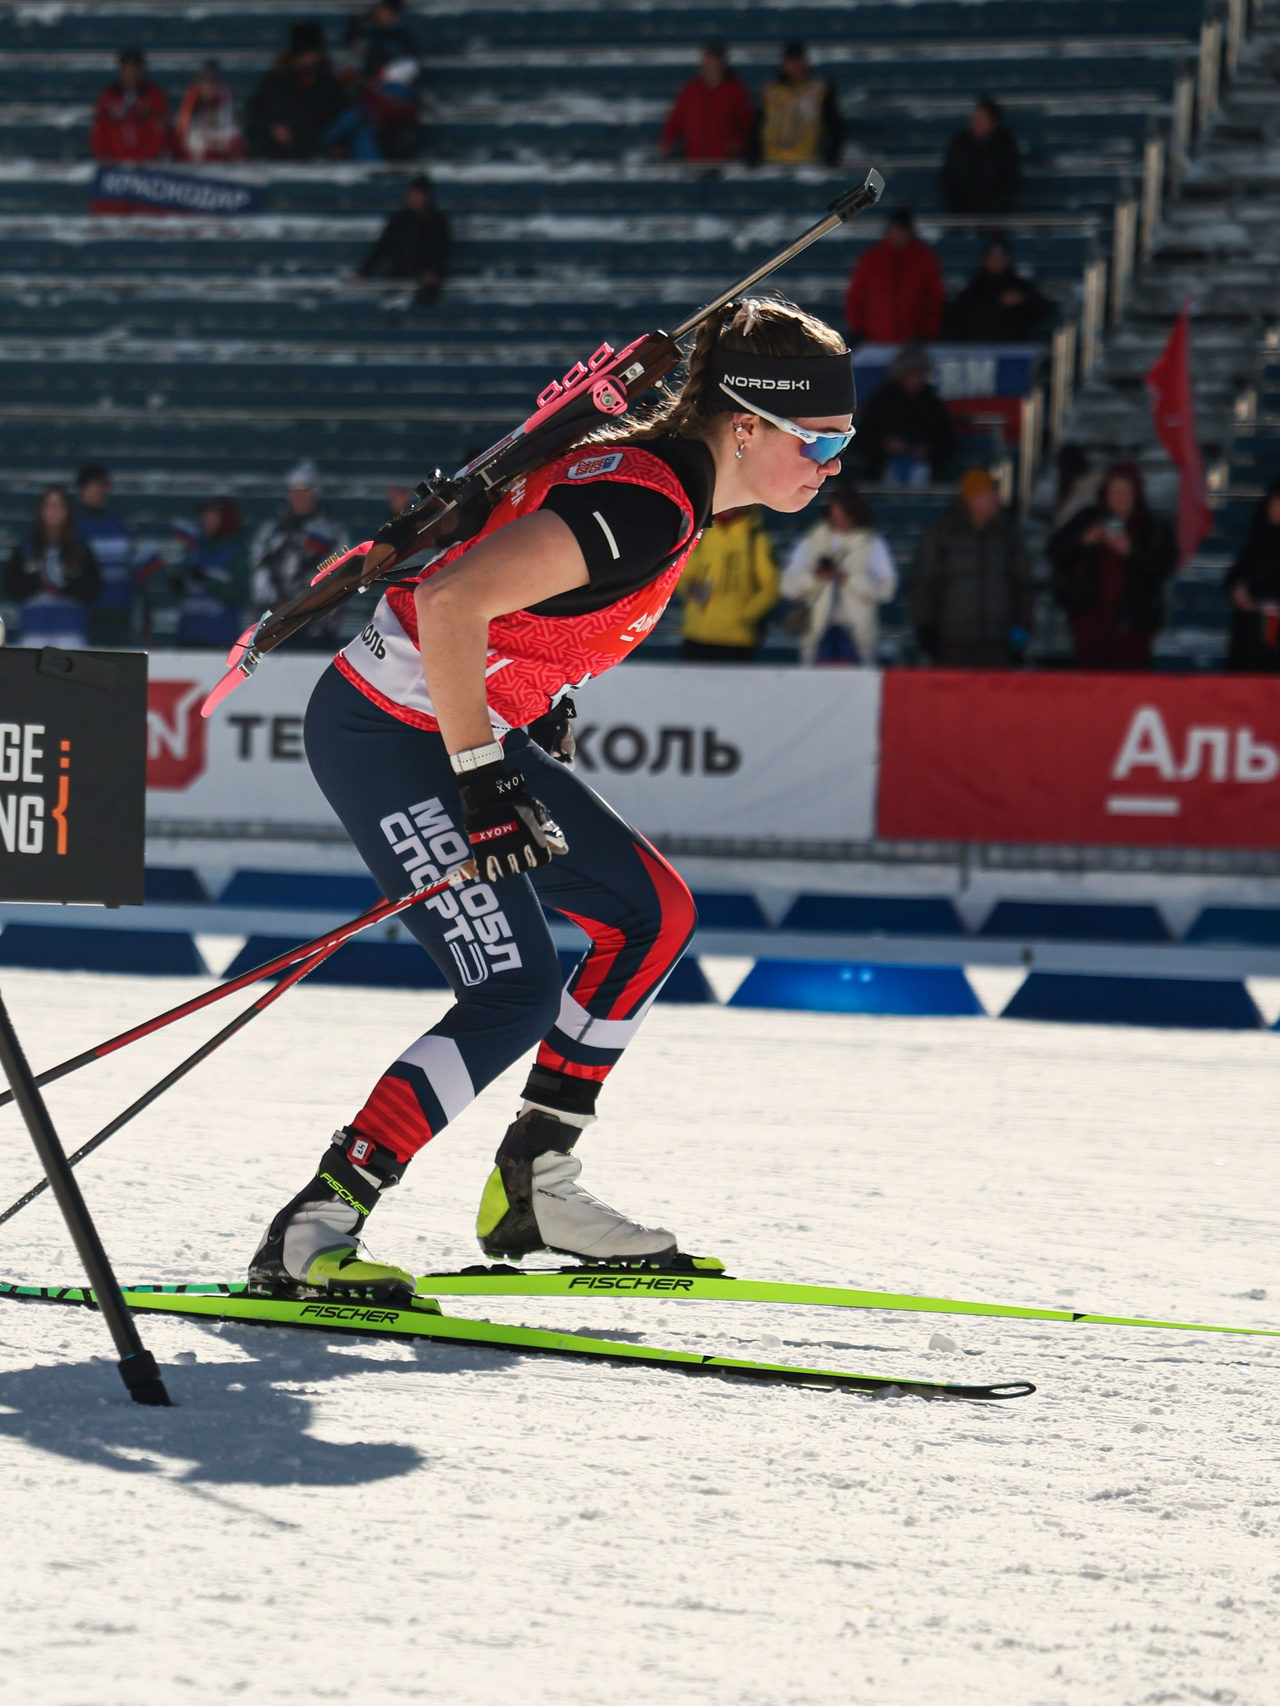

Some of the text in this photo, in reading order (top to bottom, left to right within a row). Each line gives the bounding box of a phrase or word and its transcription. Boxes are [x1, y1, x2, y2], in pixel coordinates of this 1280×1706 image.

[723, 374, 810, 391] NORDSKI
[361, 622, 386, 660] ОЛЬ
[479, 824, 513, 841] MOAX
[320, 1172, 370, 1216] FISCHER
[568, 1277, 694, 1291] FISCHER
[300, 1305, 400, 1324] FISCHER
